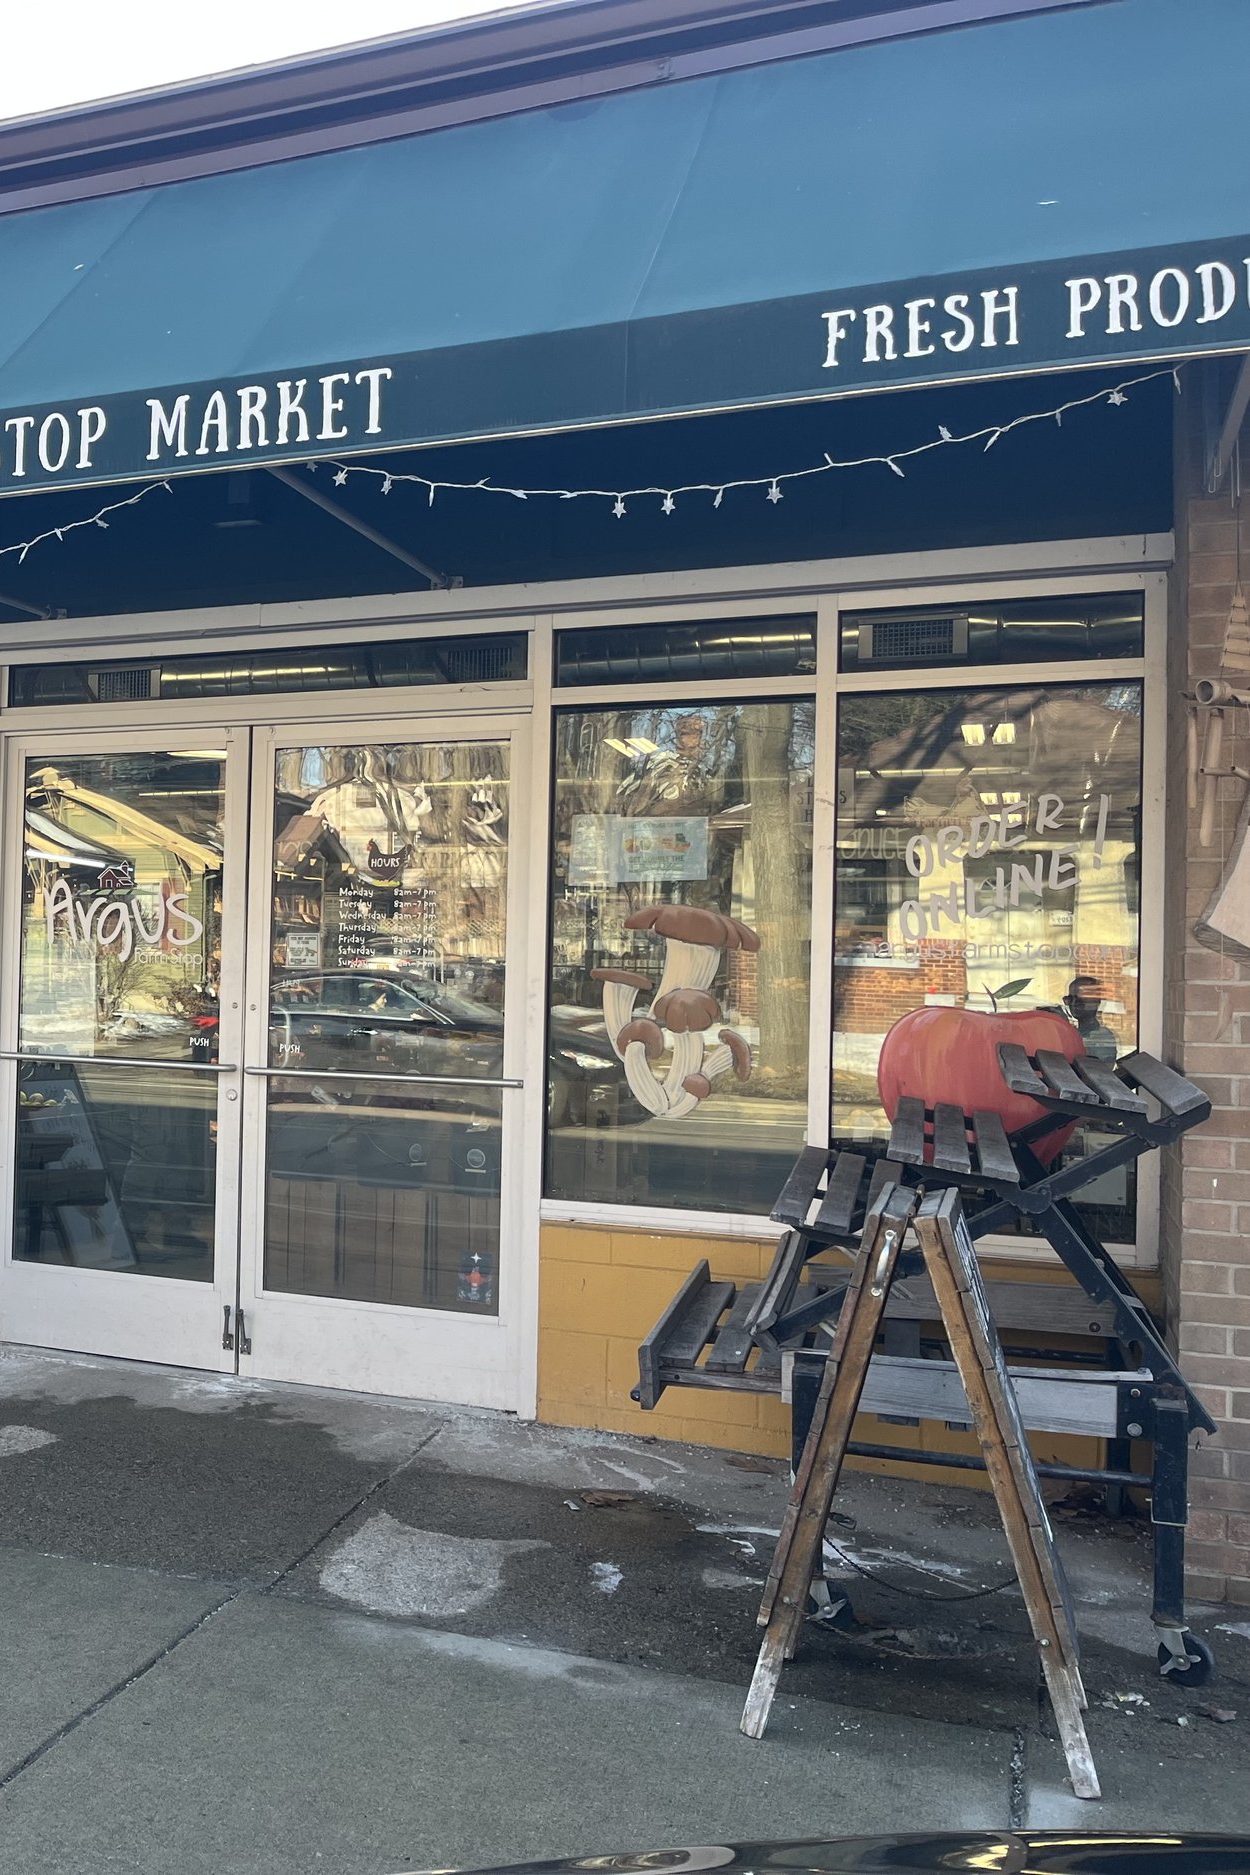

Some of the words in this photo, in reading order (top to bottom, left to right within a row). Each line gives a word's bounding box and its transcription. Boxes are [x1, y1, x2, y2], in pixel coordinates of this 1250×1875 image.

[821, 287, 1019, 367] FRESH
[145, 367, 393, 462] MARKET
[905, 793, 1065, 878] ORDER
[370, 857, 401, 868] HOURS
[339, 888, 374, 897] Monday
[339, 899, 372, 909] Tuesday
[44, 878, 203, 963] Argus
[338, 922, 377, 932] Thursday
[338, 934, 366, 945] Friday
[338, 946, 376, 955] Saturday
[189, 1037, 209, 1047] PUSH
[279, 1043, 300, 1053] PUSH
